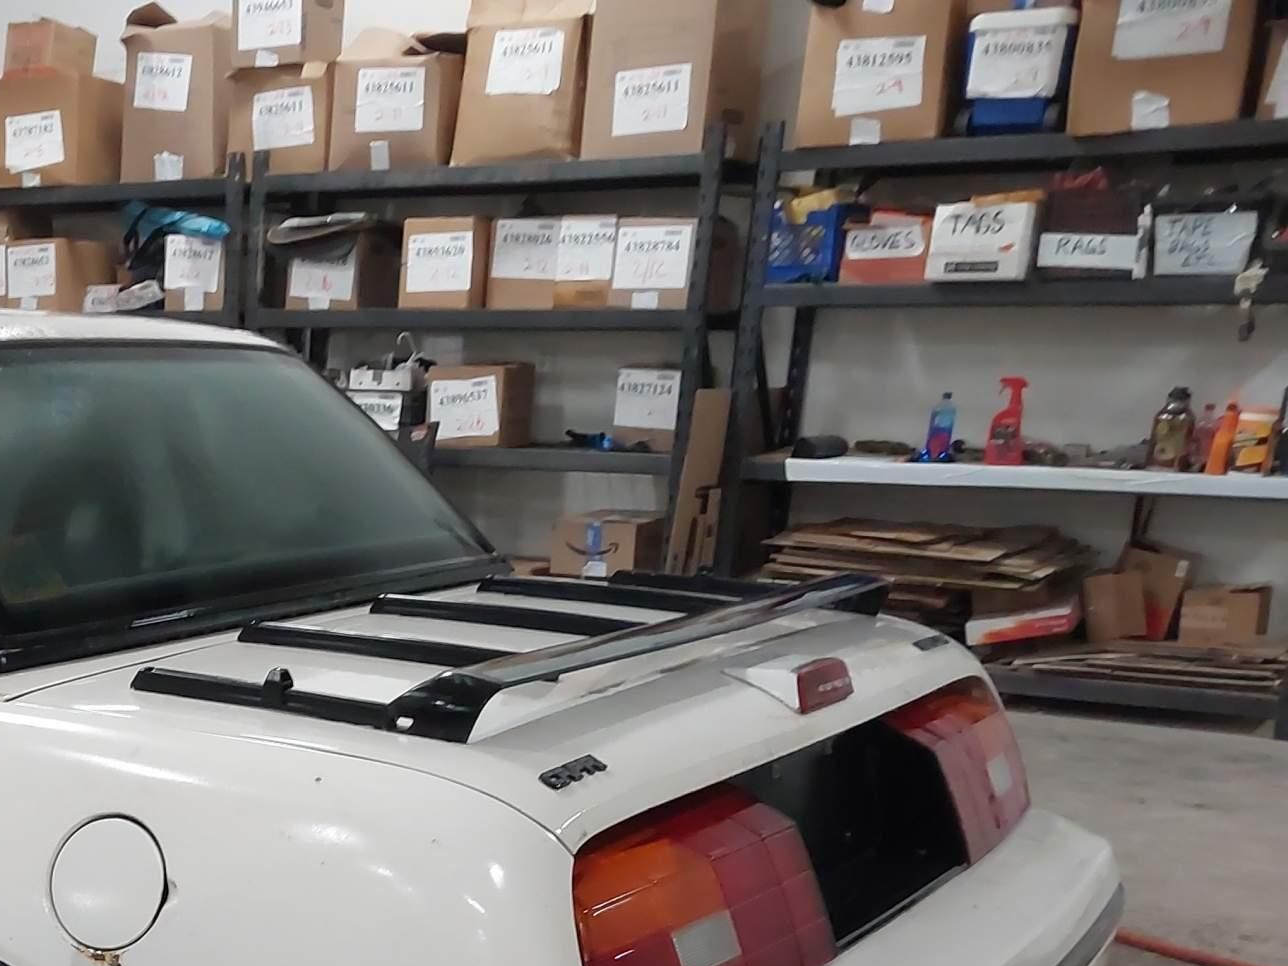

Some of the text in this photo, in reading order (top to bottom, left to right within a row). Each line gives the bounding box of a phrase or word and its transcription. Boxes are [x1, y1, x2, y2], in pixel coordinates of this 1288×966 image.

[950, 210, 1006, 235] TAGS
[850, 230, 916, 252] GLOVES
[1055, 236, 1107, 256] RAGS
